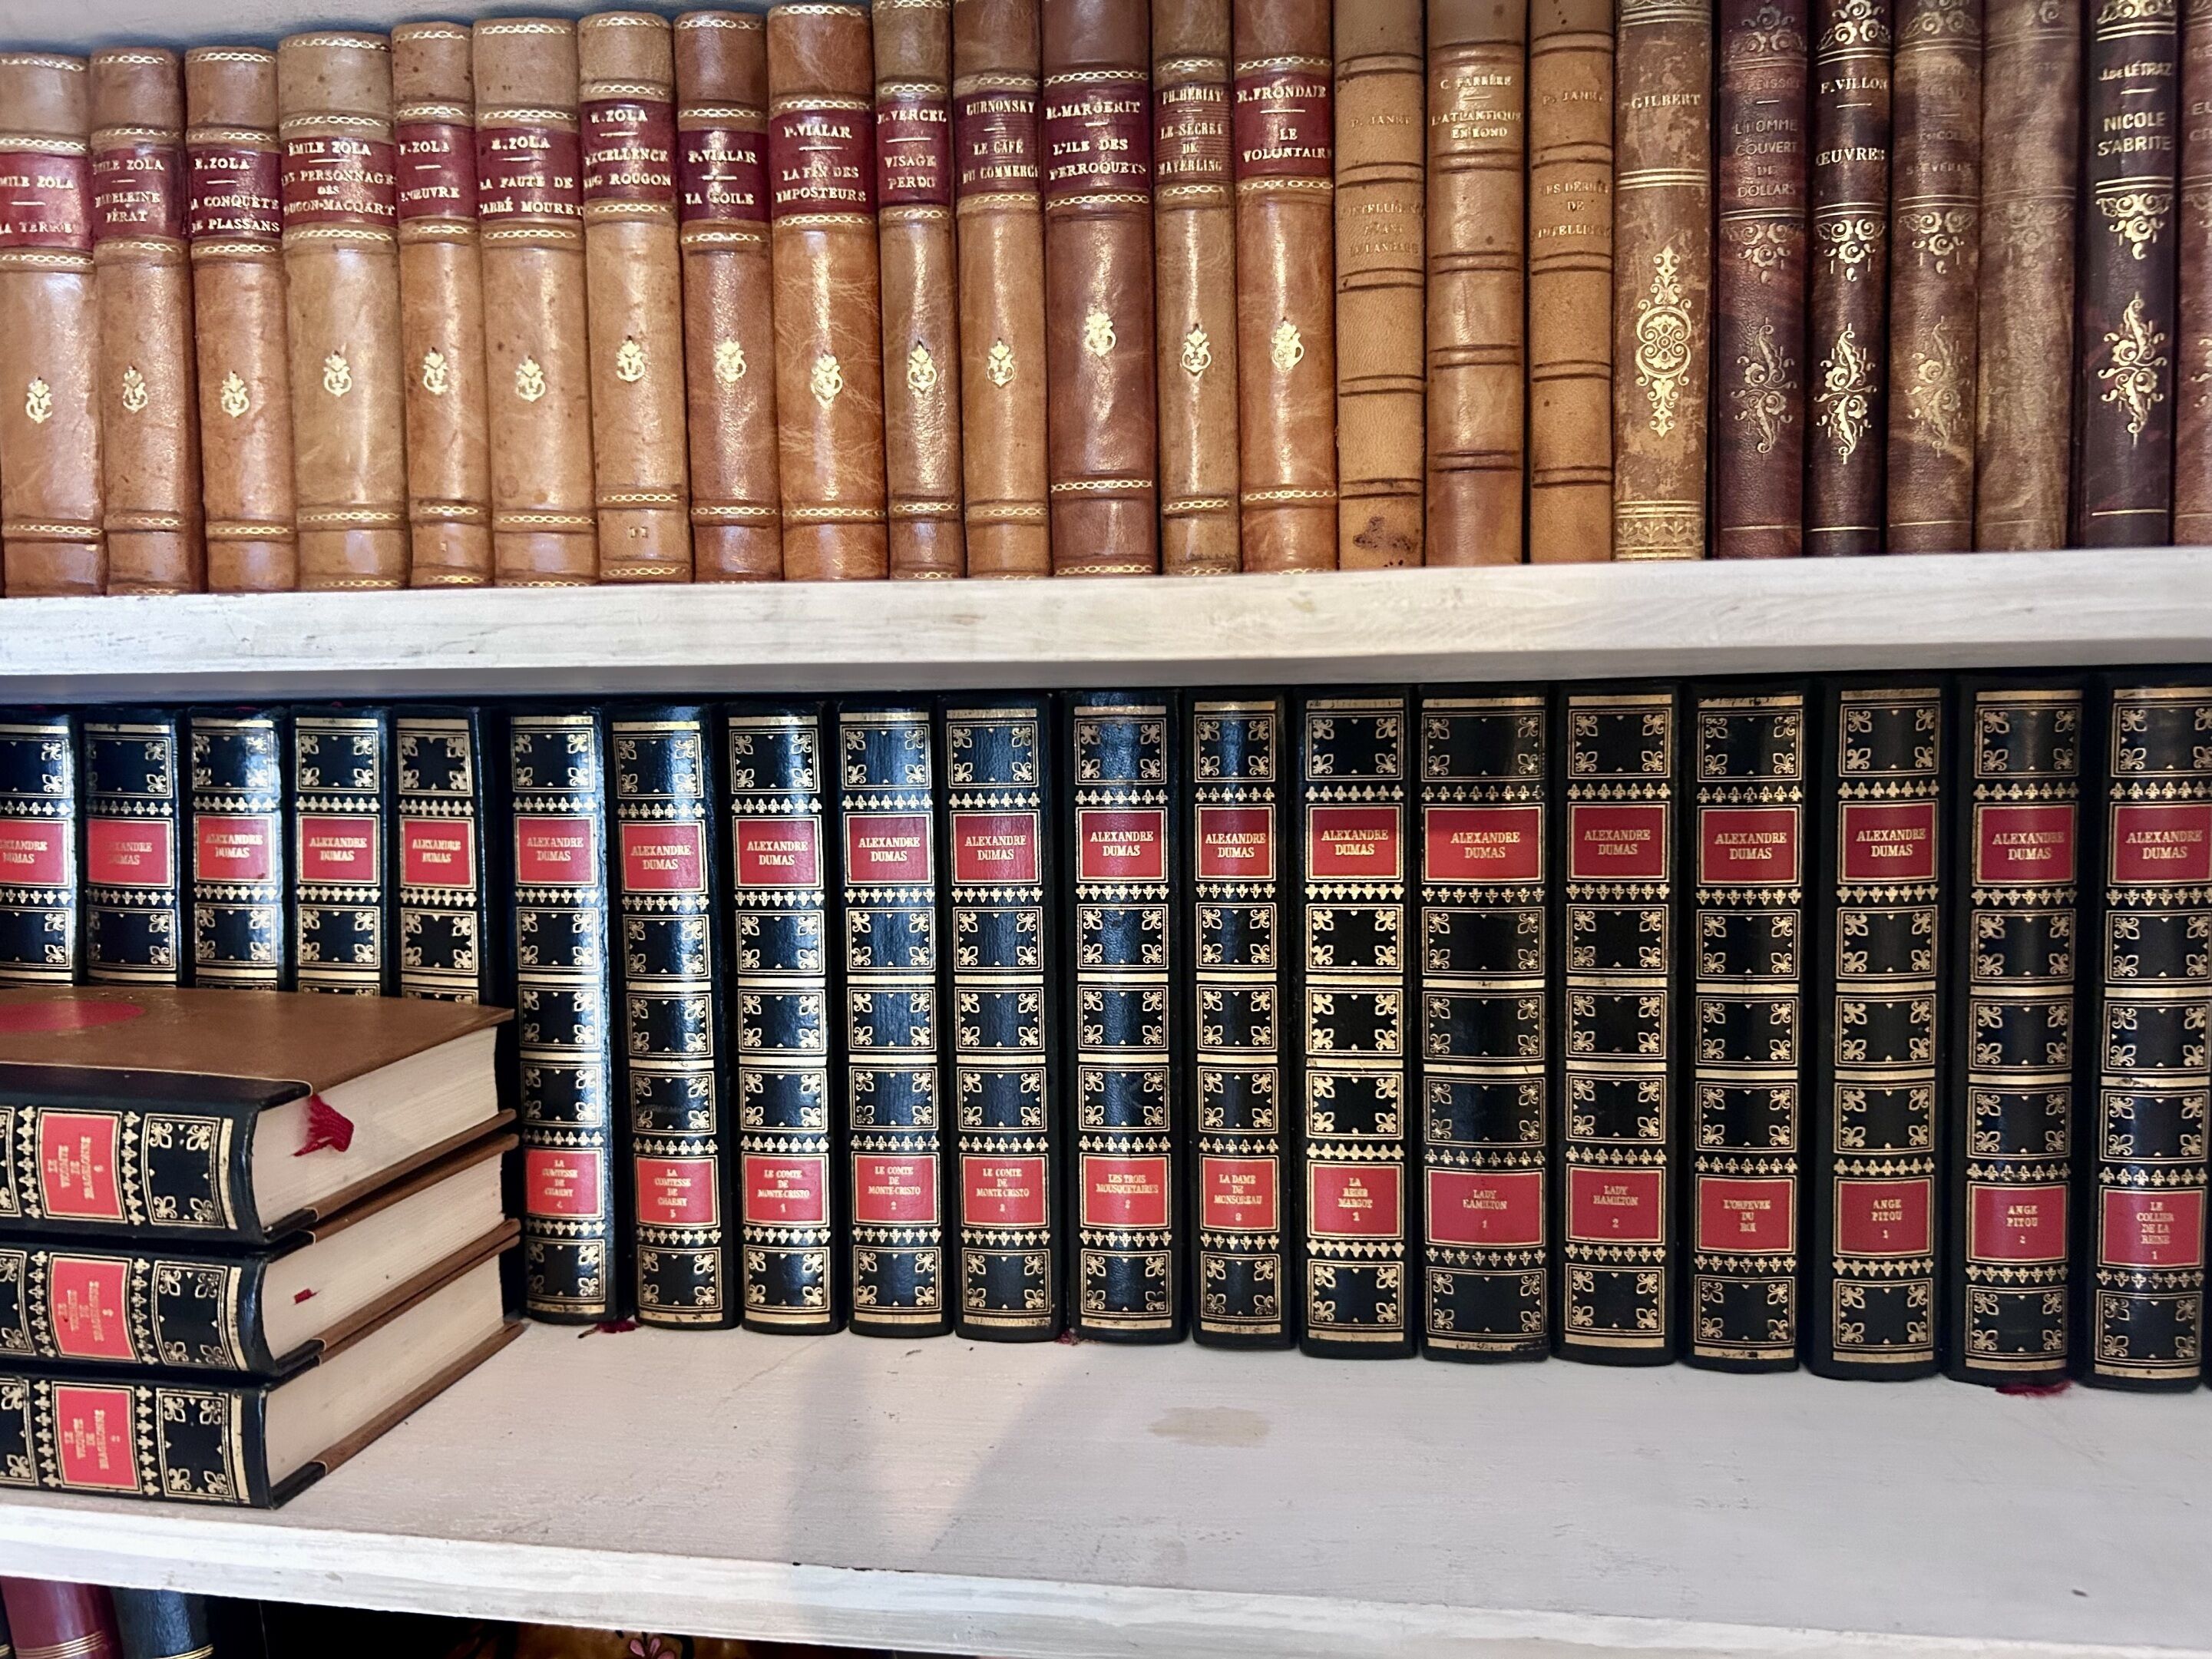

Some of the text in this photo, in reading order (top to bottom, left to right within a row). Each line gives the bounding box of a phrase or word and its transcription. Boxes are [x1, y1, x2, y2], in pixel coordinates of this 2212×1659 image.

[1820, 78, 1888, 94] F.VILLON
[1632, 94, 1701, 108] GILBERT
[966, 99, 1034, 116] CURNONSKY
[2104, 111, 2166, 132] NICOLE
[784, 124, 852, 139] P.VIALAR
[1160, 122, 1223, 140] LE SECRET
[1279, 127, 1298, 140] LE
[332, 140, 372, 156] ZOLA
[491, 135, 551, 151] E.ZOLA
[973, 138, 1023, 156] LE CAFÉ
[1099, 138, 1128, 150] DES
[1182, 142, 1198, 154] DE
[1735, 141, 1797, 157] COUVERT
[585, 147, 668, 167] EXCELLENCE
[688, 150, 758, 164] P.VIALAR
[884, 155, 937, 168] VISAGE
[127, 159, 164, 171] ZOLA
[194, 157, 250, 170] E.ZOLA
[1159, 159, 1223, 175] MAYERLING
[300, 169, 397, 184] PERSONNAGE
[782, 166, 859, 181] LA FIN DES
[1049, 161, 1146, 180] PERROQUETS
[1757, 165, 1777, 177] DE
[0, 176, 74, 189] MILE ZOLA
[500, 175, 545, 188] FAUTE
[554, 177, 574, 189] DE
[610, 172, 671, 186] ROUGON
[888, 176, 935, 190] PERDU
[776, 187, 867, 203] IMPOSTEURS
[1738, 183, 1796, 198] DOLLARS
[685, 193, 703, 205] LA
[521, 201, 584, 216] MOURET
[19, 221, 72, 233] TERRE
[208, 218, 280, 232] PLASSANS
[964, 835, 1027, 846] ALEXANDRE
[1089, 831, 1154, 842] ALEXANDRE
[1205, 833, 1266, 844] ALEXANDRE
[1321, 829, 1389, 841] ALEXANDRE
[1450, 831, 1520, 844] ALEXANDRE
[1584, 829, 1651, 841] ALEXANDRE
[1714, 832, 1787, 844] ALEXANDRE
[1856, 828, 1926, 842] ALEXANDRE
[1992, 831, 2065, 845] ALEXANDRE
[2126, 830, 2203, 844] ALEXANDRE
[309, 838, 367, 848] ALEXANDRE
[527, 837, 584, 848] ALEXANDRE
[746, 841, 808, 851] ALEXANDRE
[858, 837, 921, 848] ALEXANDRE
[631, 845, 691, 856] ALEXANDRE
[977, 849, 1014, 861] DUMAS
[1103, 844, 1141, 857] DUMAS
[1217, 847, 1255, 858] DUMAS
[1334, 844, 1375, 856] DUMAS
[1464, 847, 1506, 859] DUMAS
[1597, 844, 1638, 855] DUMAS
[1729, 848, 1772, 860] DUMAS
[1870, 844, 1913, 857] DUMAS
[2008, 848, 2052, 861] DUMAS
[2142, 847, 2187, 860] DUMAS
[320, 851, 355, 861] DUMAS
[537, 851, 571, 861] DUMAS
[759, 854, 795, 866] DUMAS
[871, 851, 908, 862] DUMAS
[643, 859, 678, 870] DUMAS
[764, 1170, 802, 1178] LE COMTE
[875, 1166, 914, 1175] LE COMTE
[983, 1168, 1023, 1177] LE COMTE
[777, 1180, 789, 1188] DE
[888, 1177, 900, 1185] DE
[997, 1178, 1008, 1187] DE
[1108, 1174, 1146, 1183] LES TROIS
[1218, 1174, 1256, 1185] LA DAME
[1348, 1178, 1362, 1187] LA
[757, 1190, 810, 1199] MONTE-CRISTO
[868, 1186, 921, 1195] MONTE-CRISTO
[976, 1188, 1030, 1197] MONTE-CRISTO
[1232, 1185, 1245, 1194] DE
[1473, 1189, 1496, 1199] LADY
[1604, 1185, 1629, 1195] LADY
[1213, 1195, 1263, 1205] MONSOREAU
[1463, 1199, 1508, 1210] HAMILTON
[1593, 1195, 1638, 1206] HAMILTON
[1873, 1199, 1902, 1210] ANGE
[2151, 1201, 2163, 1211] LE
[780, 1204, 785, 1213] 1
[2008, 1205, 2038, 1215] ANGE
[1352, 1211, 1361, 1221] 1
[1741, 1212, 1754, 1221] DU
[1871, 1211, 1903, 1221] PITOU
[2136, 1212, 2174, 1222] COLLIER
[1482, 1220, 1487, 1228] 1
[1612, 1218, 1618, 1228] 2
[2007, 1217, 2038, 1228] PITOU
[1883, 1229, 1889, 1239] 1
[2141, 1224, 2170, 1234] DE LA
[2019, 1235, 2025, 1244] 2
[2141, 1234, 2171, 1244] REINE
[2152, 1251, 2157, 1260] 1
